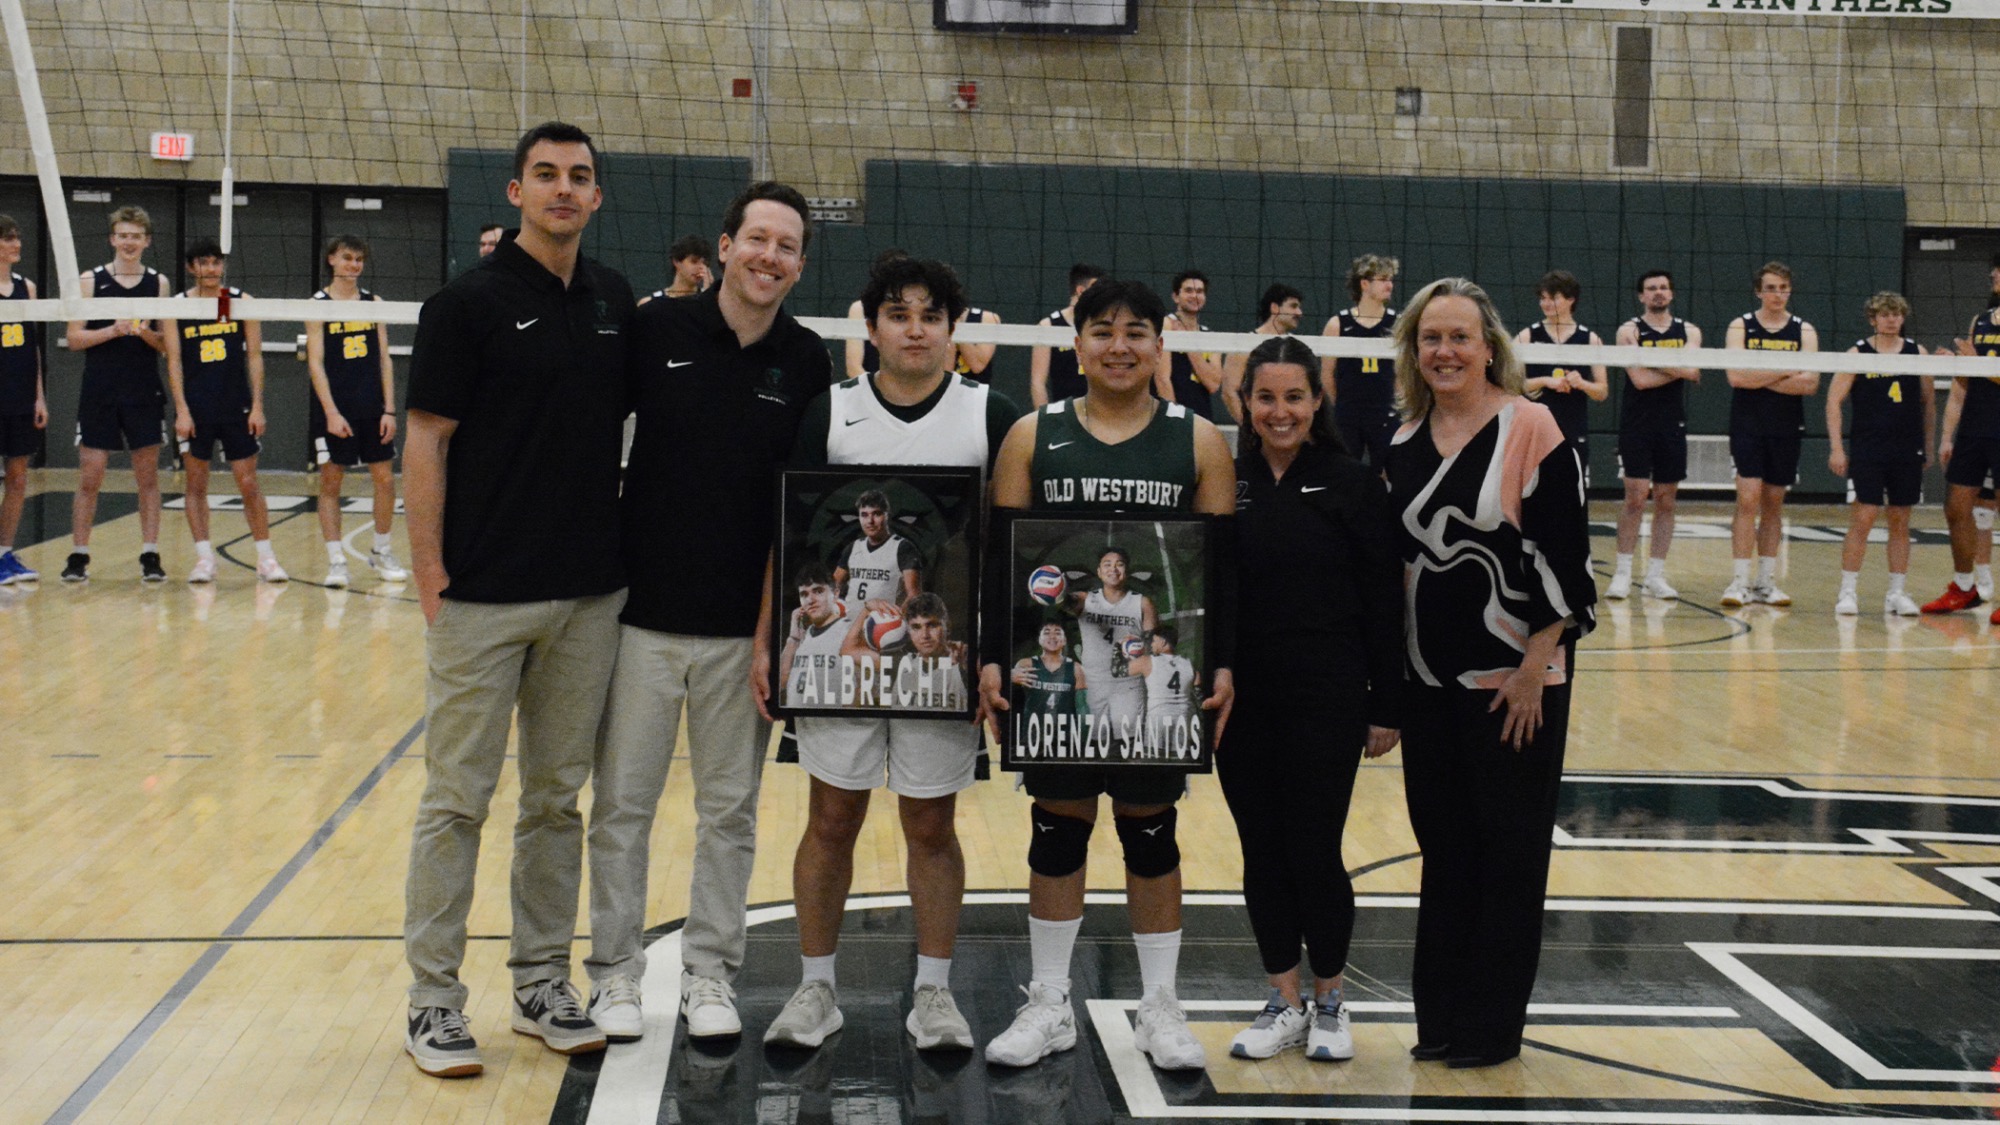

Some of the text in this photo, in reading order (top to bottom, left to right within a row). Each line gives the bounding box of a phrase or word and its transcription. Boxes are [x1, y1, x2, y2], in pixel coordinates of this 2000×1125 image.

[159, 135, 187, 157] EXIT
[200, 338, 227, 363] 26
[343, 334, 368, 360] 25
[1887, 381, 1903, 404] 4
[1043, 477, 1184, 508] OLD WESTBURY
[857, 582, 869, 601] 6
[1085, 612, 1136, 628] PANTHERS
[1103, 627, 1115, 645] 4
[802, 655, 953, 708] ALBRECHT
[1167, 670, 1181, 695] 4
[1046, 692, 1056, 710] 4
[1015, 712, 1201, 760] LORENZO SANTOS
